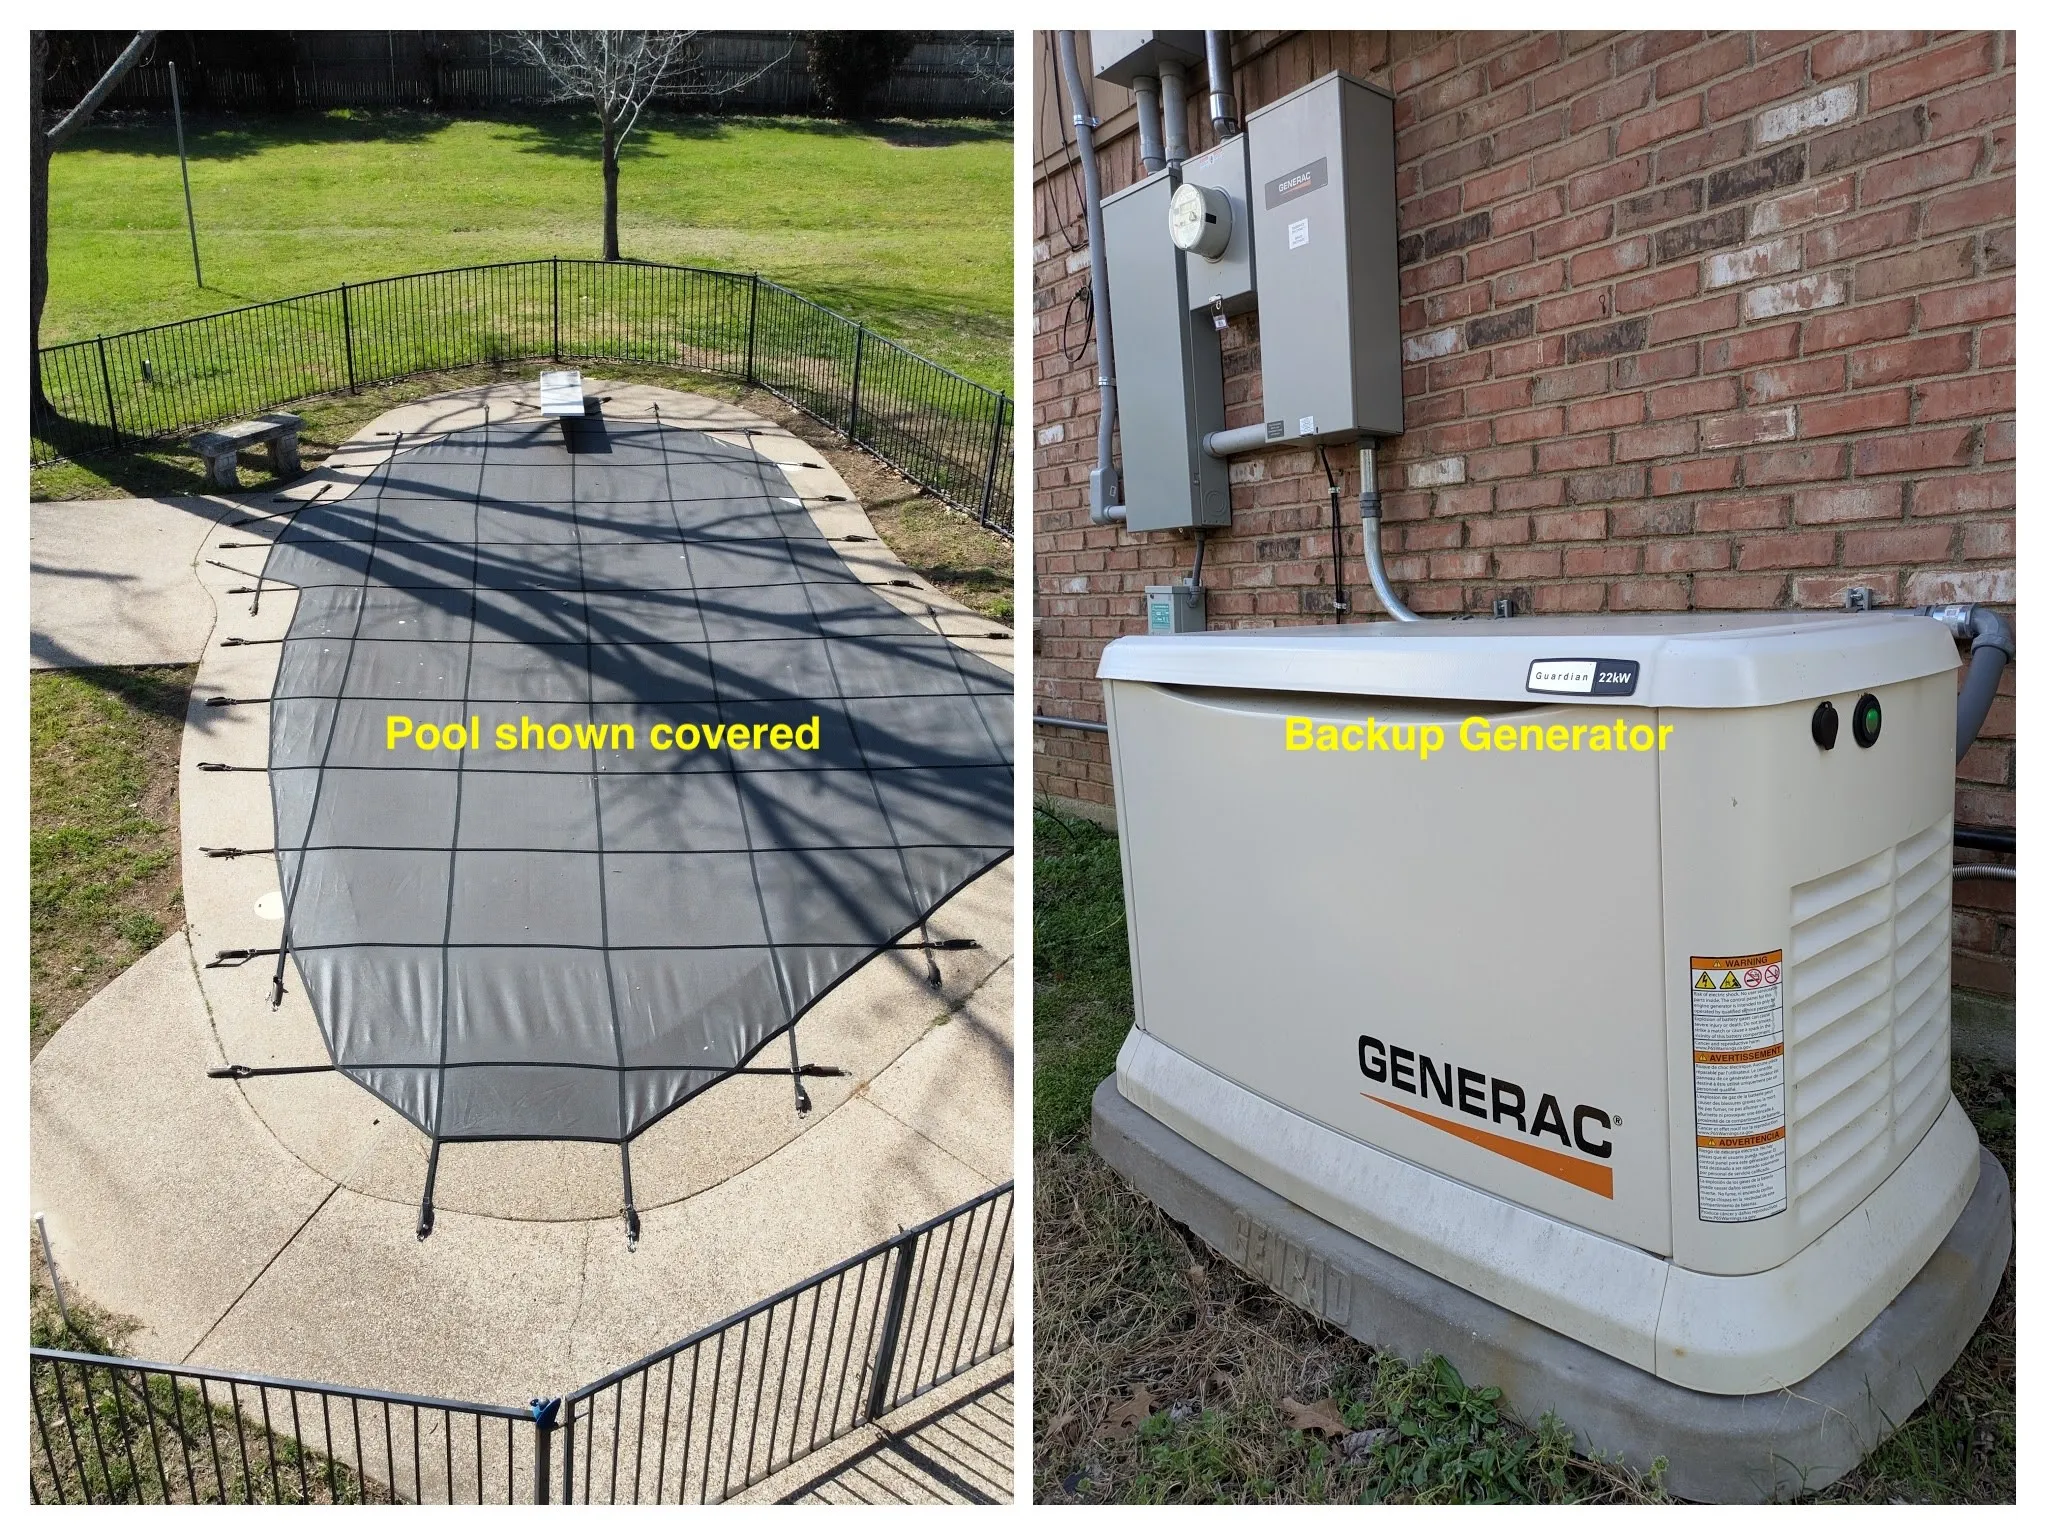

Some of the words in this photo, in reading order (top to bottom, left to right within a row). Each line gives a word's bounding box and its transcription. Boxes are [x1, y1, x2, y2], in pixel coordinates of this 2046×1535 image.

[1278, 172, 1310, 192] GENERAC
[1536, 672, 1588, 681] Guardian
[1598, 672, 1632, 684] 22kW
[1726, 956, 1768, 968] WARNING
[1710, 1046, 1782, 1062] AVERTISSEMENT
[1719, 1131, 1780, 1146] ADVERTENCIA
